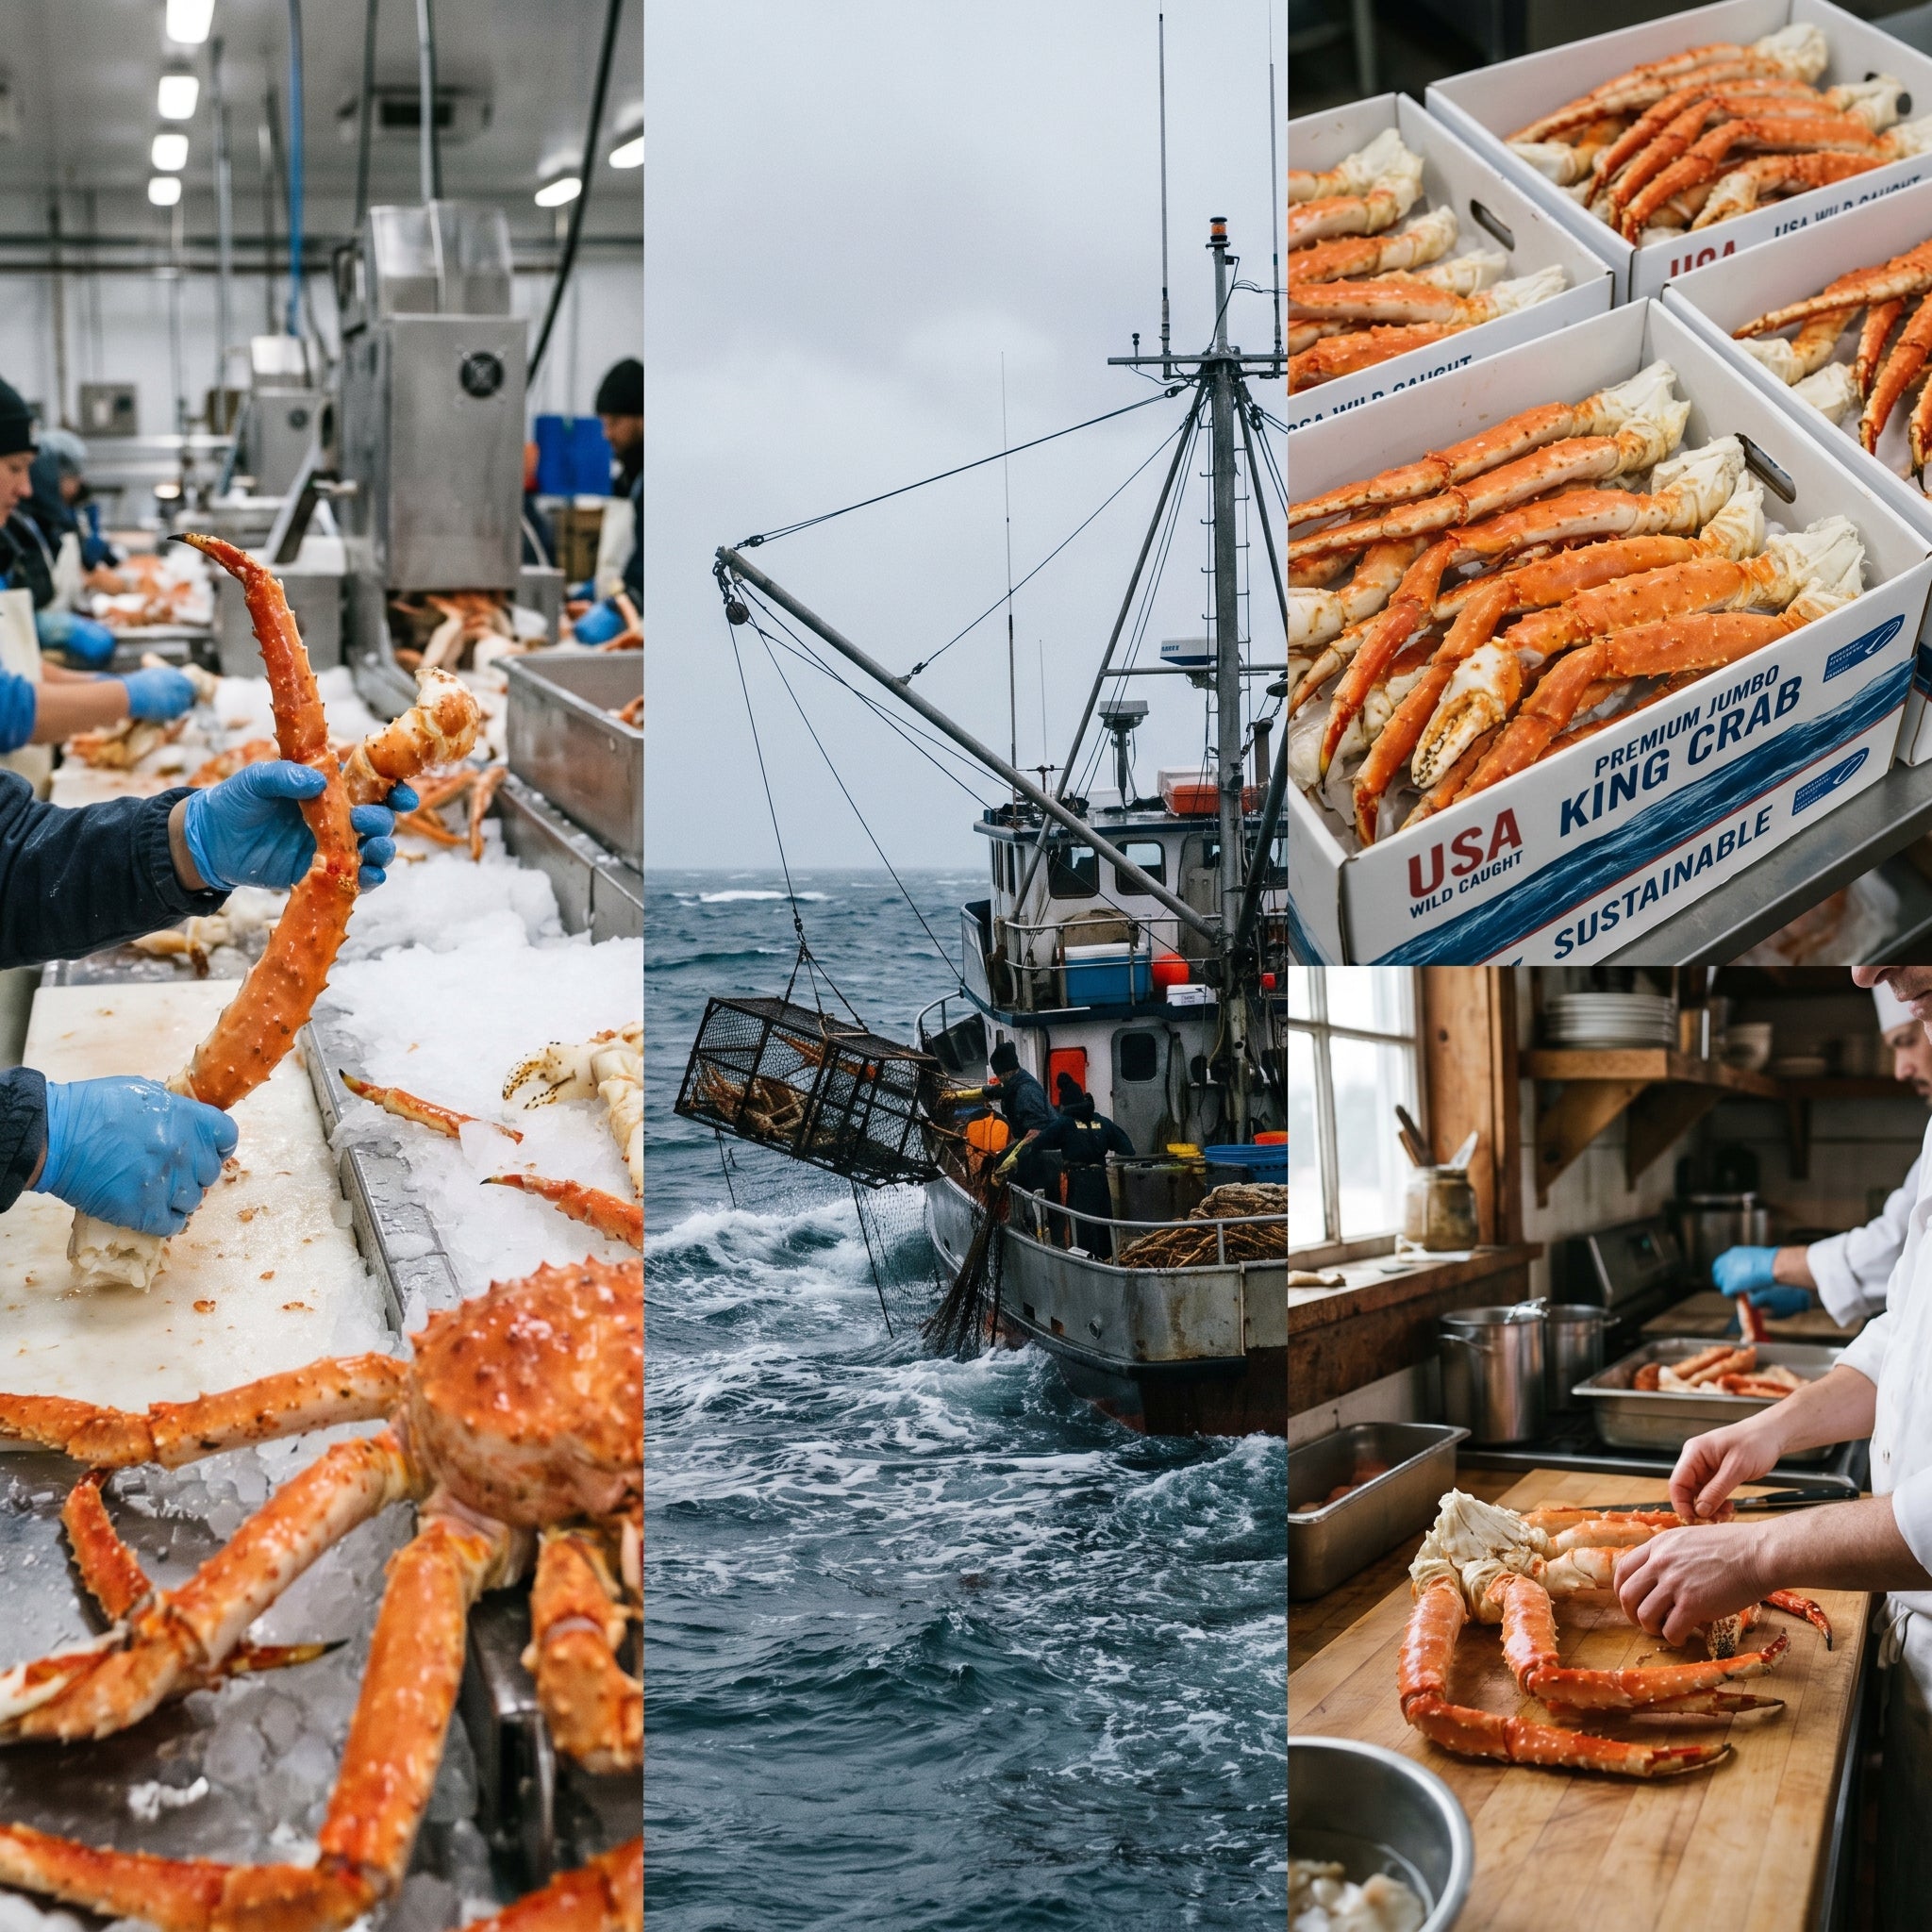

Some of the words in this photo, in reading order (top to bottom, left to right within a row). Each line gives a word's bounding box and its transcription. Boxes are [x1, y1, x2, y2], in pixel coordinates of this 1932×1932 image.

[1560, 749, 1670, 838] KING
[1688, 675, 1803, 766] CRAB
[1594, 707, 1700, 778] PREMIUM
[1707, 665, 1779, 719] JUMBO
[1408, 808, 1523, 898] USA
[1410, 888, 1453, 919] WILD
[1458, 850, 1524, 893] CAUGHT
[1554, 805, 1774, 959] SUSTAINABLE
